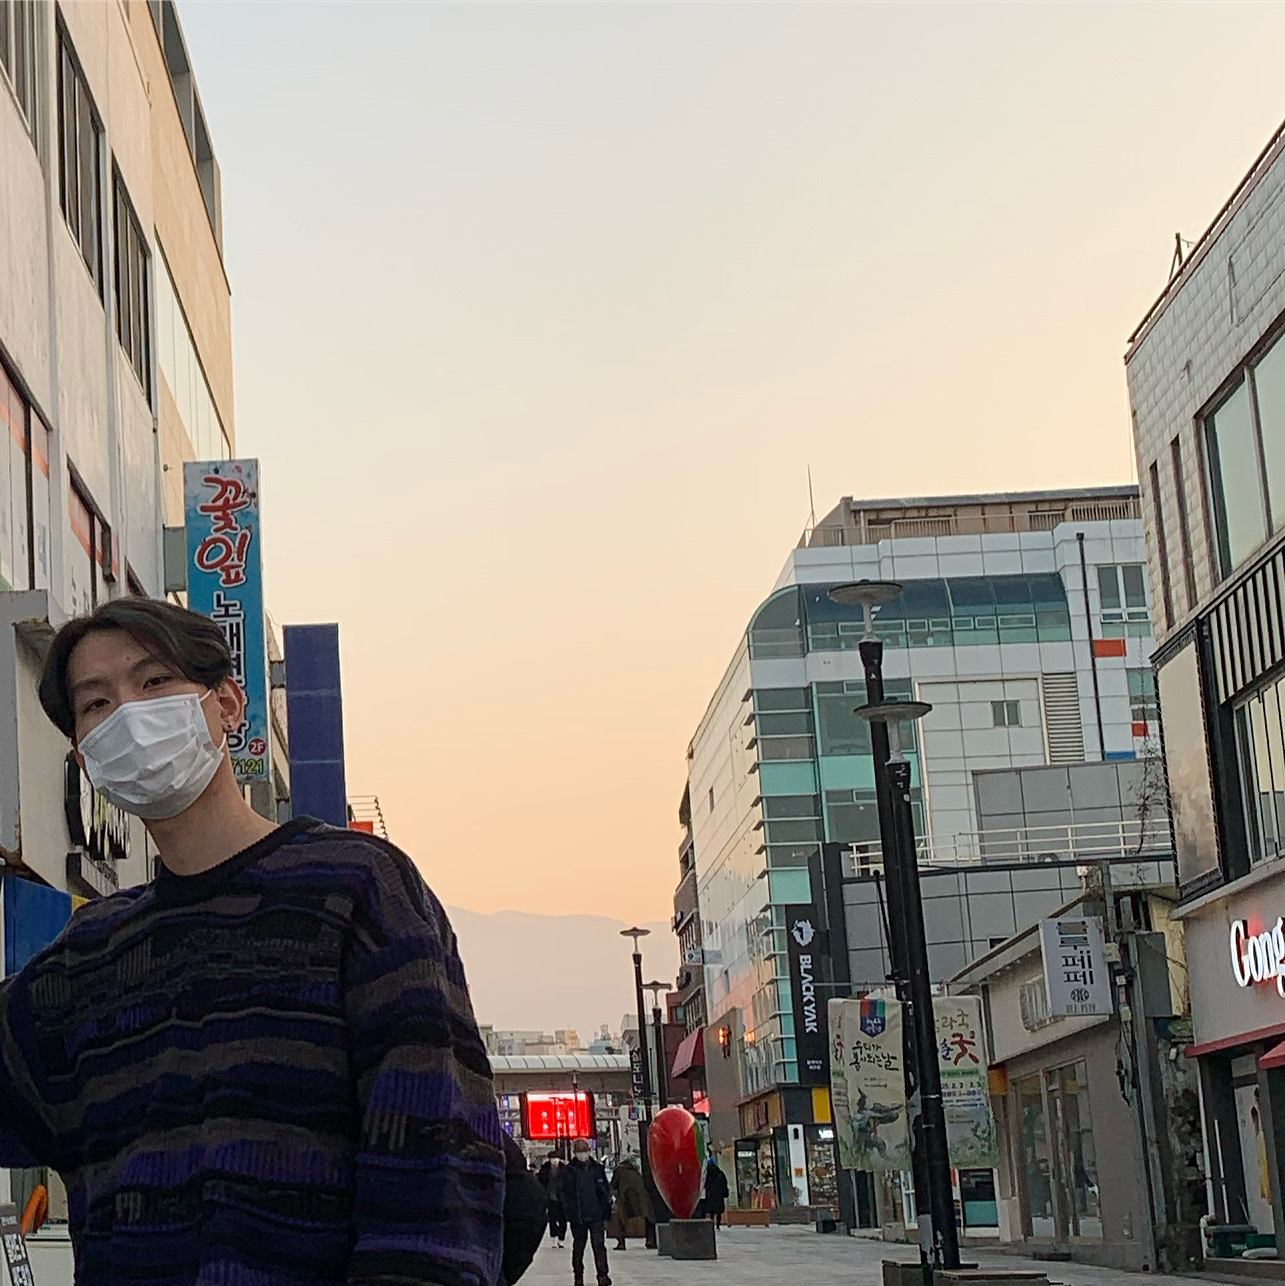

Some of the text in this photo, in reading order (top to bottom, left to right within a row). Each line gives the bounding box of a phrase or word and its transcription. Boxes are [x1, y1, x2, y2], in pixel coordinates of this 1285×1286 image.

[195, 476, 249, 586] 꽃잎
[250, 741, 264, 753] 2F
[799, 954, 818, 1034] BLACKYAK
[852, 1040, 881, 1055] 우리가
